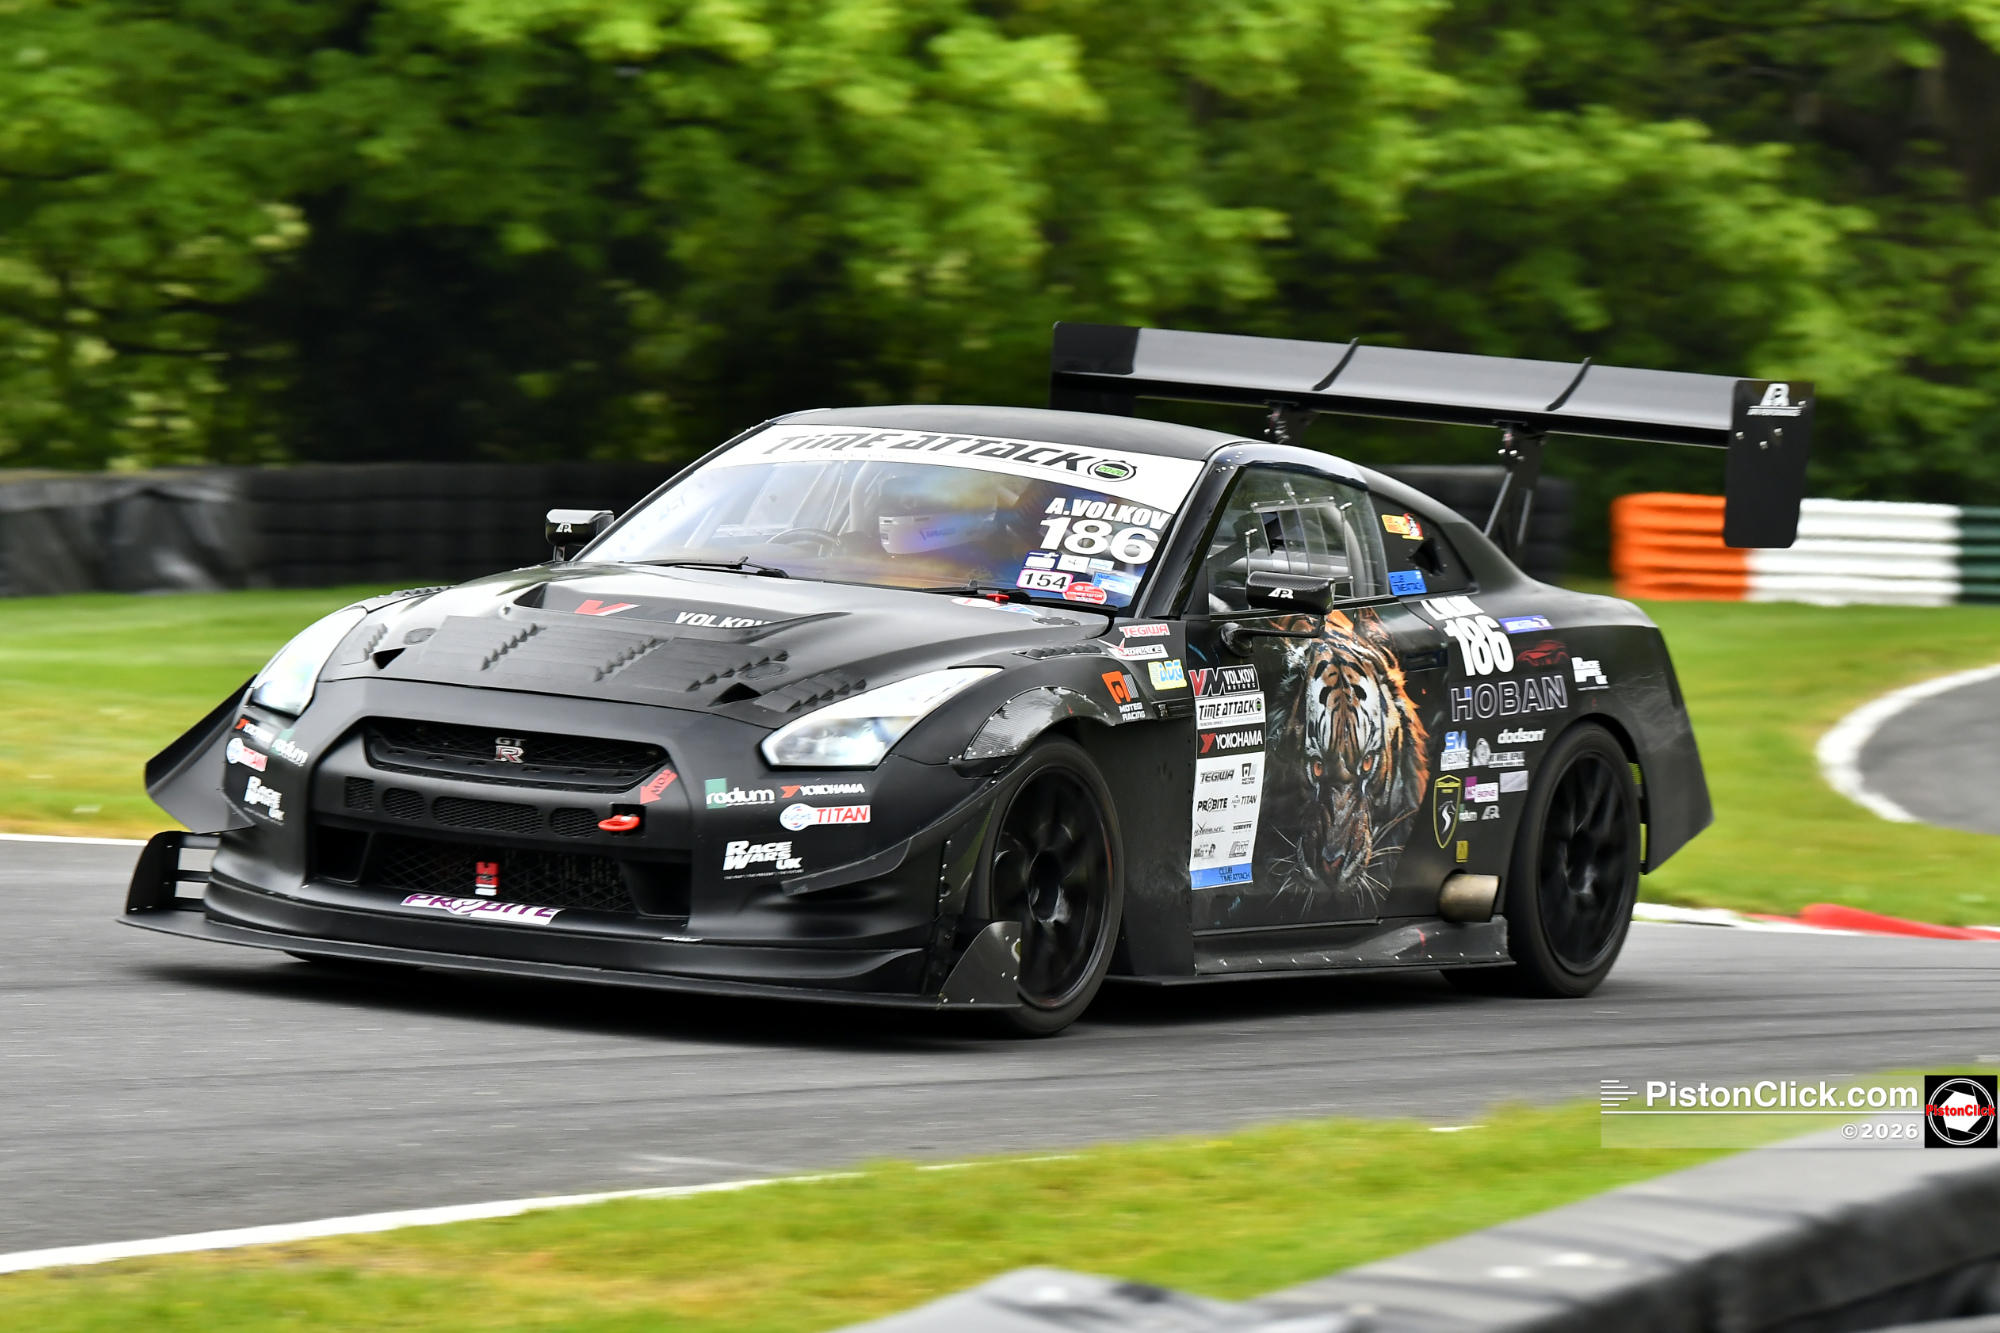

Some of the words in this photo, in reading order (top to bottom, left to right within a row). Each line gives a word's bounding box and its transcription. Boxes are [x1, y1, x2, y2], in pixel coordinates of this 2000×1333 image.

[1045, 497, 1173, 530] A.VOLKOV
[1039, 516, 1159, 565] 186
[1024, 572, 1067, 589] 154
[1121, 625, 1169, 636] TEGIWA
[1443, 614, 1515, 677] 186
[1222, 668, 1255, 685] VOLKOV
[1227, 683, 1256, 691] MOTORS
[1451, 674, 1568, 721] HOBAN
[1122, 711, 1145, 721] RACING
[495, 736, 527, 747] GT
[1215, 730, 1263, 750] YOKOHAMA
[1497, 728, 1544, 744] dodson
[494, 745, 525, 764] R
[1200, 769, 1235, 784] TEGIWA
[800, 783, 866, 796] YOKOHAMA
[817, 807, 869, 823] TITAN
[725, 840, 793, 857] RACE
[722, 849, 792, 871] WARS
[775, 857, 803, 870] UK
[1219, 867, 1232, 875] CLUB
[1220, 873, 1233, 882] TIME
[1233, 871, 1251, 881] ATTACK
